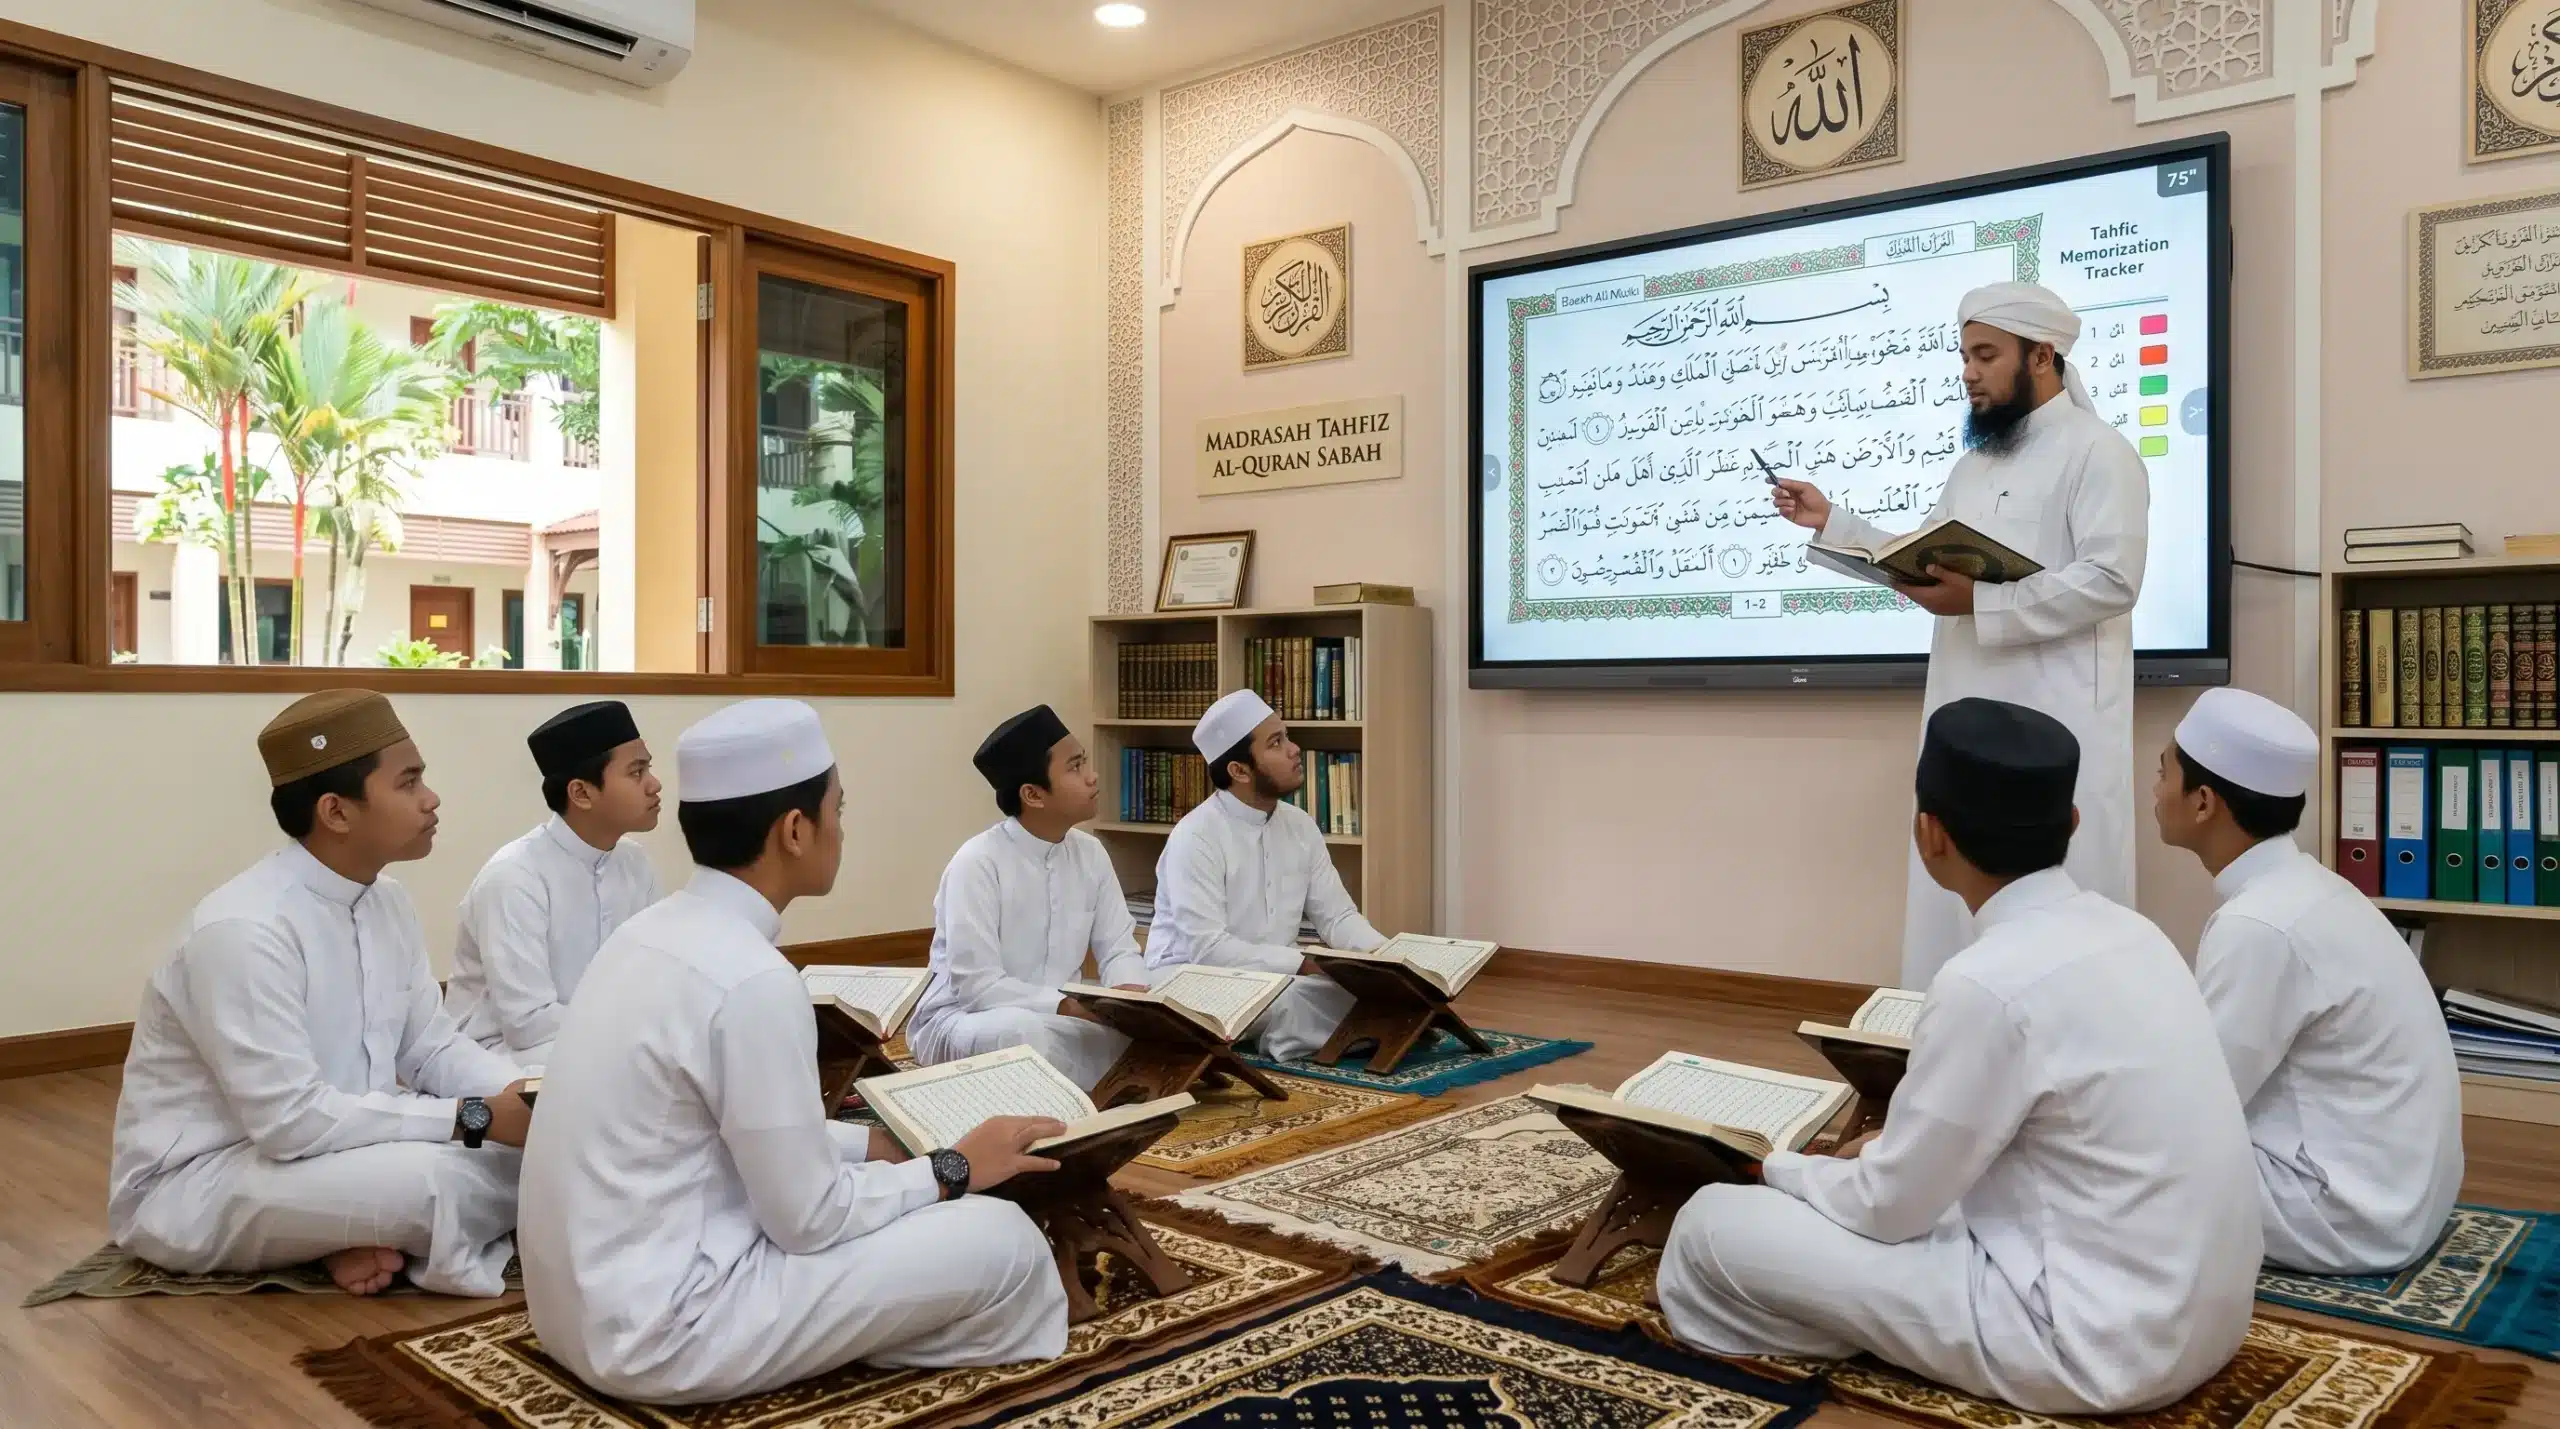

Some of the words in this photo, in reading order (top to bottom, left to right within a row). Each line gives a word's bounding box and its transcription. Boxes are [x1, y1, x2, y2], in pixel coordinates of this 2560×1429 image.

[2167, 168, 2197, 188] 75"
[2090, 221, 2138, 240] Tahfic
[2060, 238, 2169, 264] Memorization
[2084, 262, 2145, 280] Tracker
[2091, 326, 2097, 339] 1
[2090, 356, 2098, 368] 2
[2090, 386, 2098, 397] 3
[1205, 422, 1311, 452] MADRASAH
[1317, 412, 1390, 439] TAHFIZ
[1212, 450, 1311, 478] AL-QURAN
[1317, 442, 1382, 468] SABAH
[1744, 598, 1766, 610] 1-2
